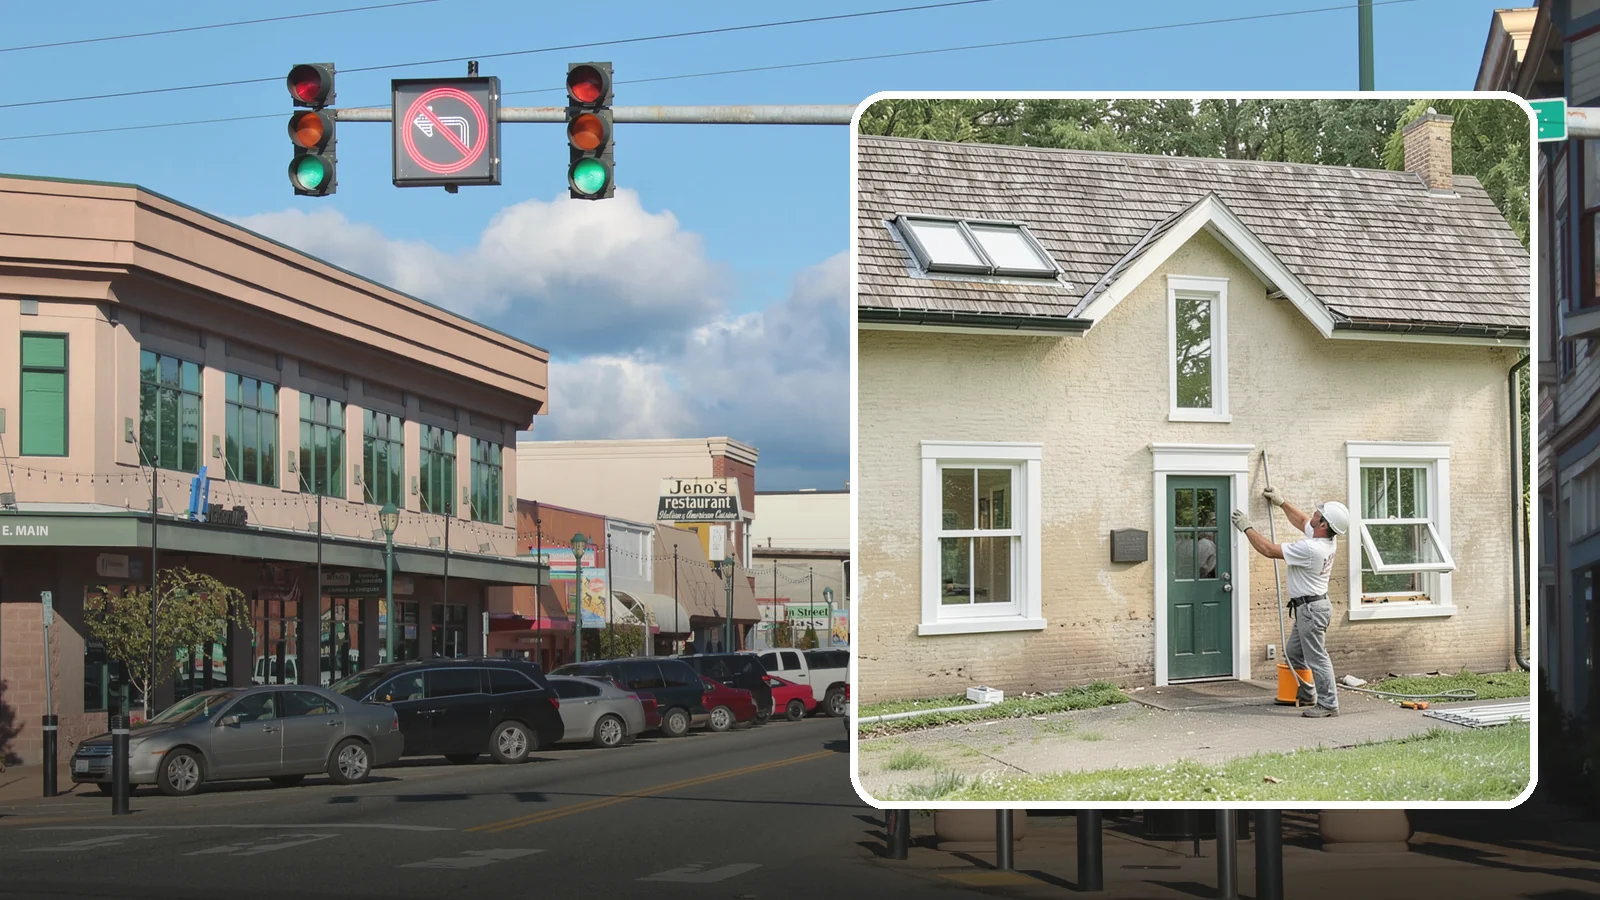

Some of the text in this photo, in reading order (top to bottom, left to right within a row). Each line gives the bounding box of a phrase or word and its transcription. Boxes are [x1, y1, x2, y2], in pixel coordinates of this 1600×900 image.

[670, 480, 727, 494] Jeno's
[665, 497, 731, 509] restaurant
[659, 510, 682, 520] Italian
[686, 510, 714, 519] American
[715, 509, 738, 519] Cuisine
[2, 525, 49, 536] E. MAIN
[798, 608, 828, 617] Street
